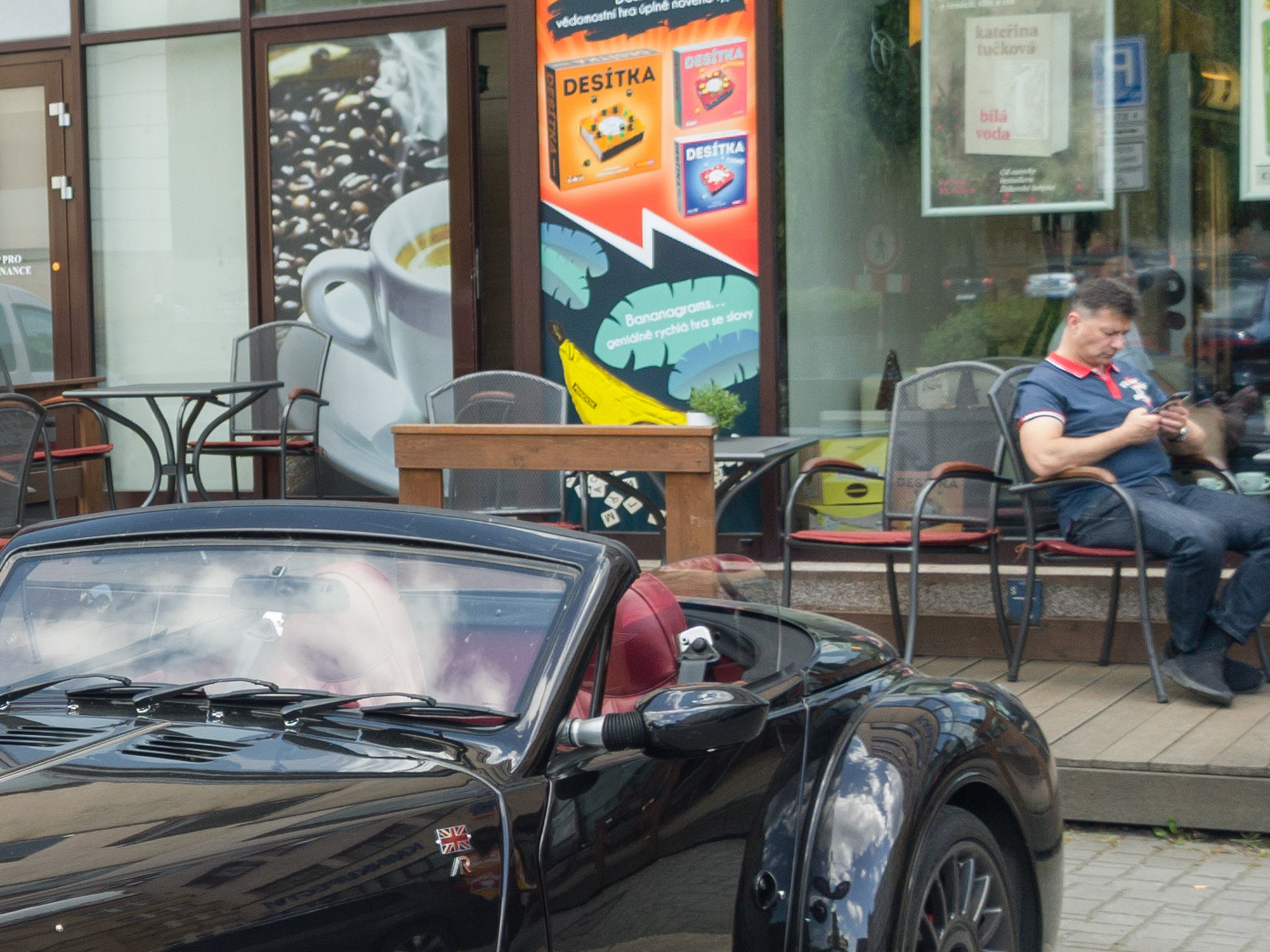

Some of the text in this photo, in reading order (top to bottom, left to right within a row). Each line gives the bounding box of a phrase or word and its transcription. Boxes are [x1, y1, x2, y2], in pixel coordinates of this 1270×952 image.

[555, 8, 617, 29] vědomostní
[618, 6, 637, 19] hra
[638, 2, 670, 18] úplně
[975, 25, 1039, 40] kateřina
[684, 47, 744, 70] DESÍTKA
[563, 65, 656, 97] DESÍTKA
[975, 127, 1011, 141] voda
[686, 140, 745, 162] DESÍTKA
[2, 254, 22, 265] PRO
[606, 308, 755, 351] geniálně rychlá hra se slovy
